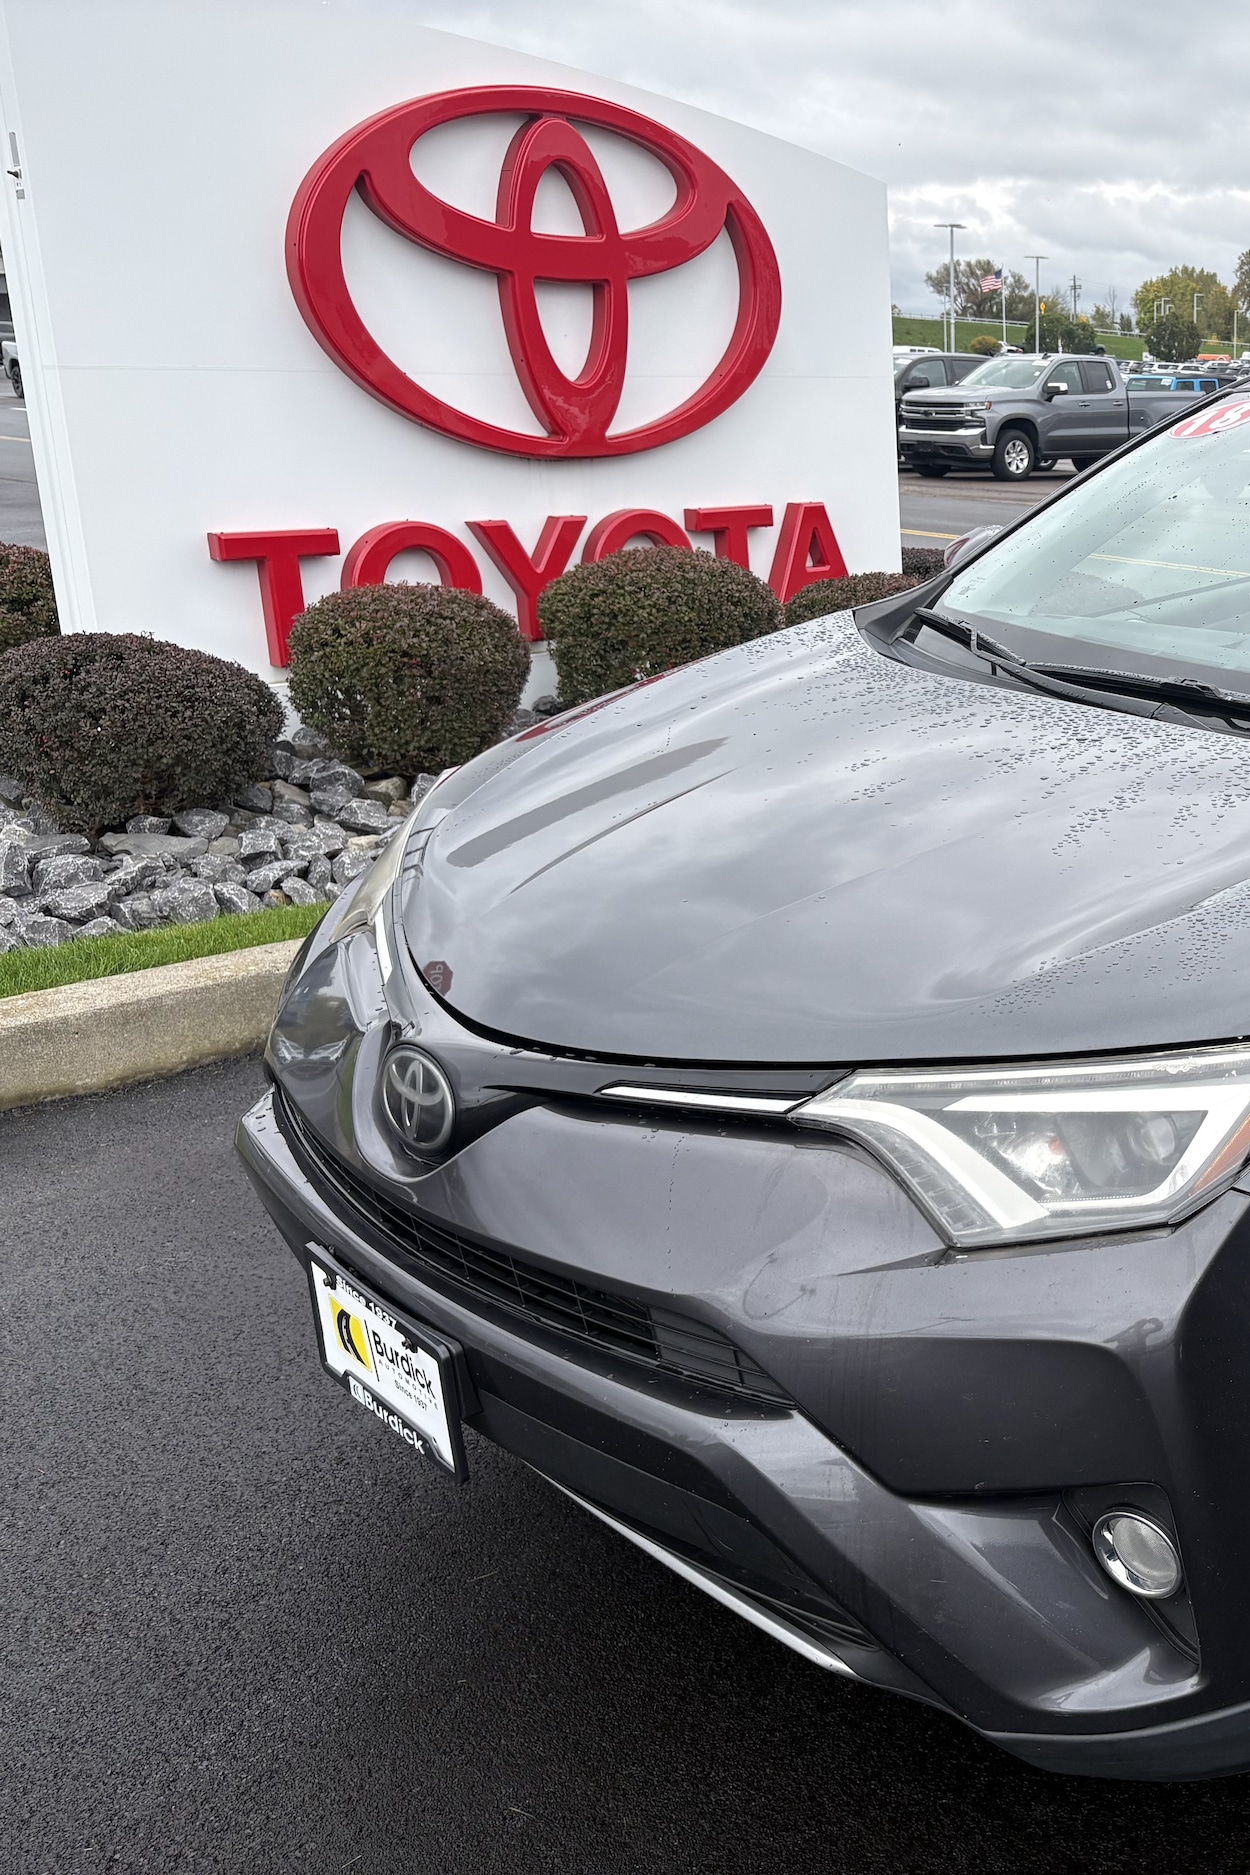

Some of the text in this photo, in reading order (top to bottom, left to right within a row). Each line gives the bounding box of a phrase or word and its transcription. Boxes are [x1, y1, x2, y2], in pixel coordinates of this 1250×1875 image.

[335, 1275, 397, 1329] Since 1937
[372, 1329, 436, 1400] Burdick
[378, 1360, 439, 1410] AUTOMOTIVE
[395, 1379, 413, 1399] Since
[364, 1389, 425, 1455] Burdick
